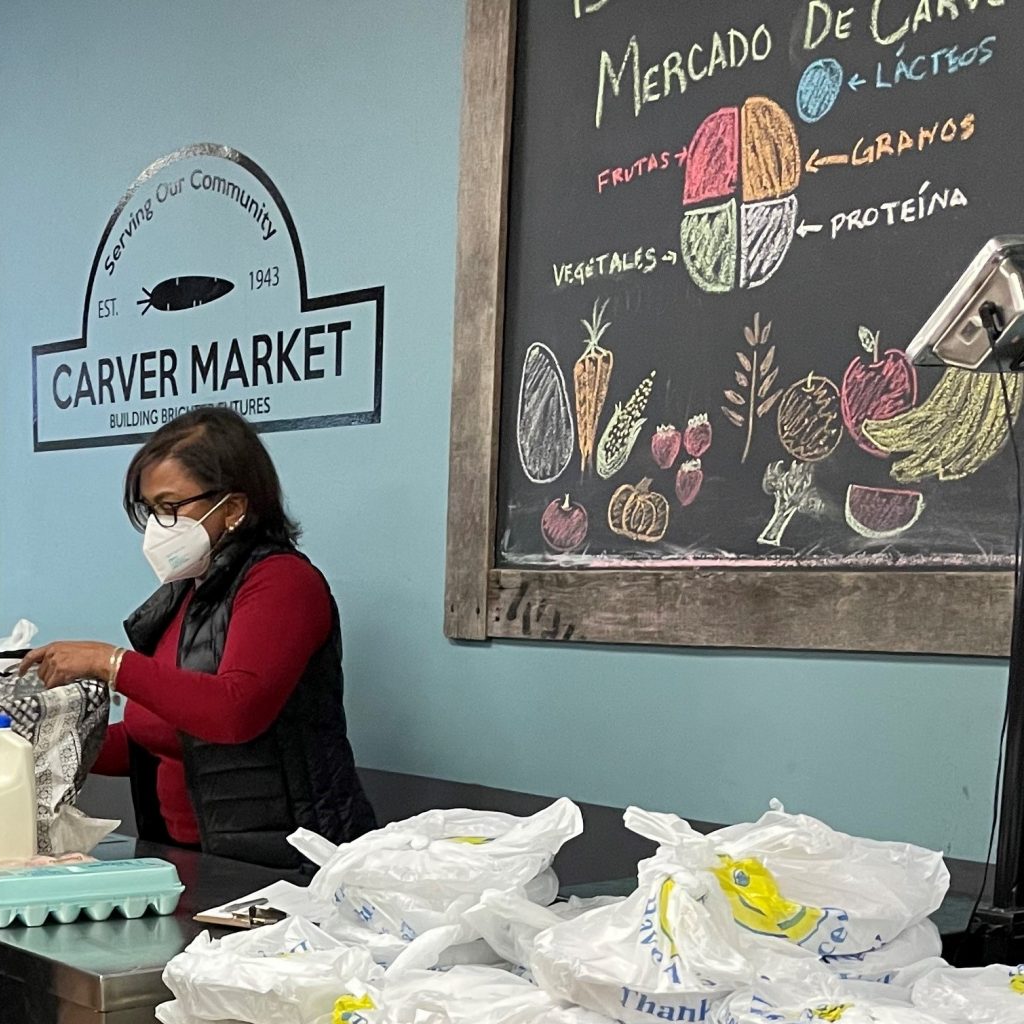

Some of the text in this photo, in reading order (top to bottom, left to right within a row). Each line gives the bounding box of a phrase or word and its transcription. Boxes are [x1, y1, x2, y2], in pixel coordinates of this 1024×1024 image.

[595, 24, 772, 128] MERCADO
[875, 36, 997, 89] LÁCTEOS
[852, 113, 976, 166] GRANOS
[597, 152, 671, 193] FRUTAS
[104, 169, 277, 276] Serving Our Community
[830, 181, 969, 238] PROTEÍNA
[248, 266, 280, 290] 1943
[553, 246, 658, 287] VEGETALES
[97, 298, 119, 319] EST.
[52, 320, 352, 411] CARVER MARKET
[109, 409, 159, 429] BUILDING
